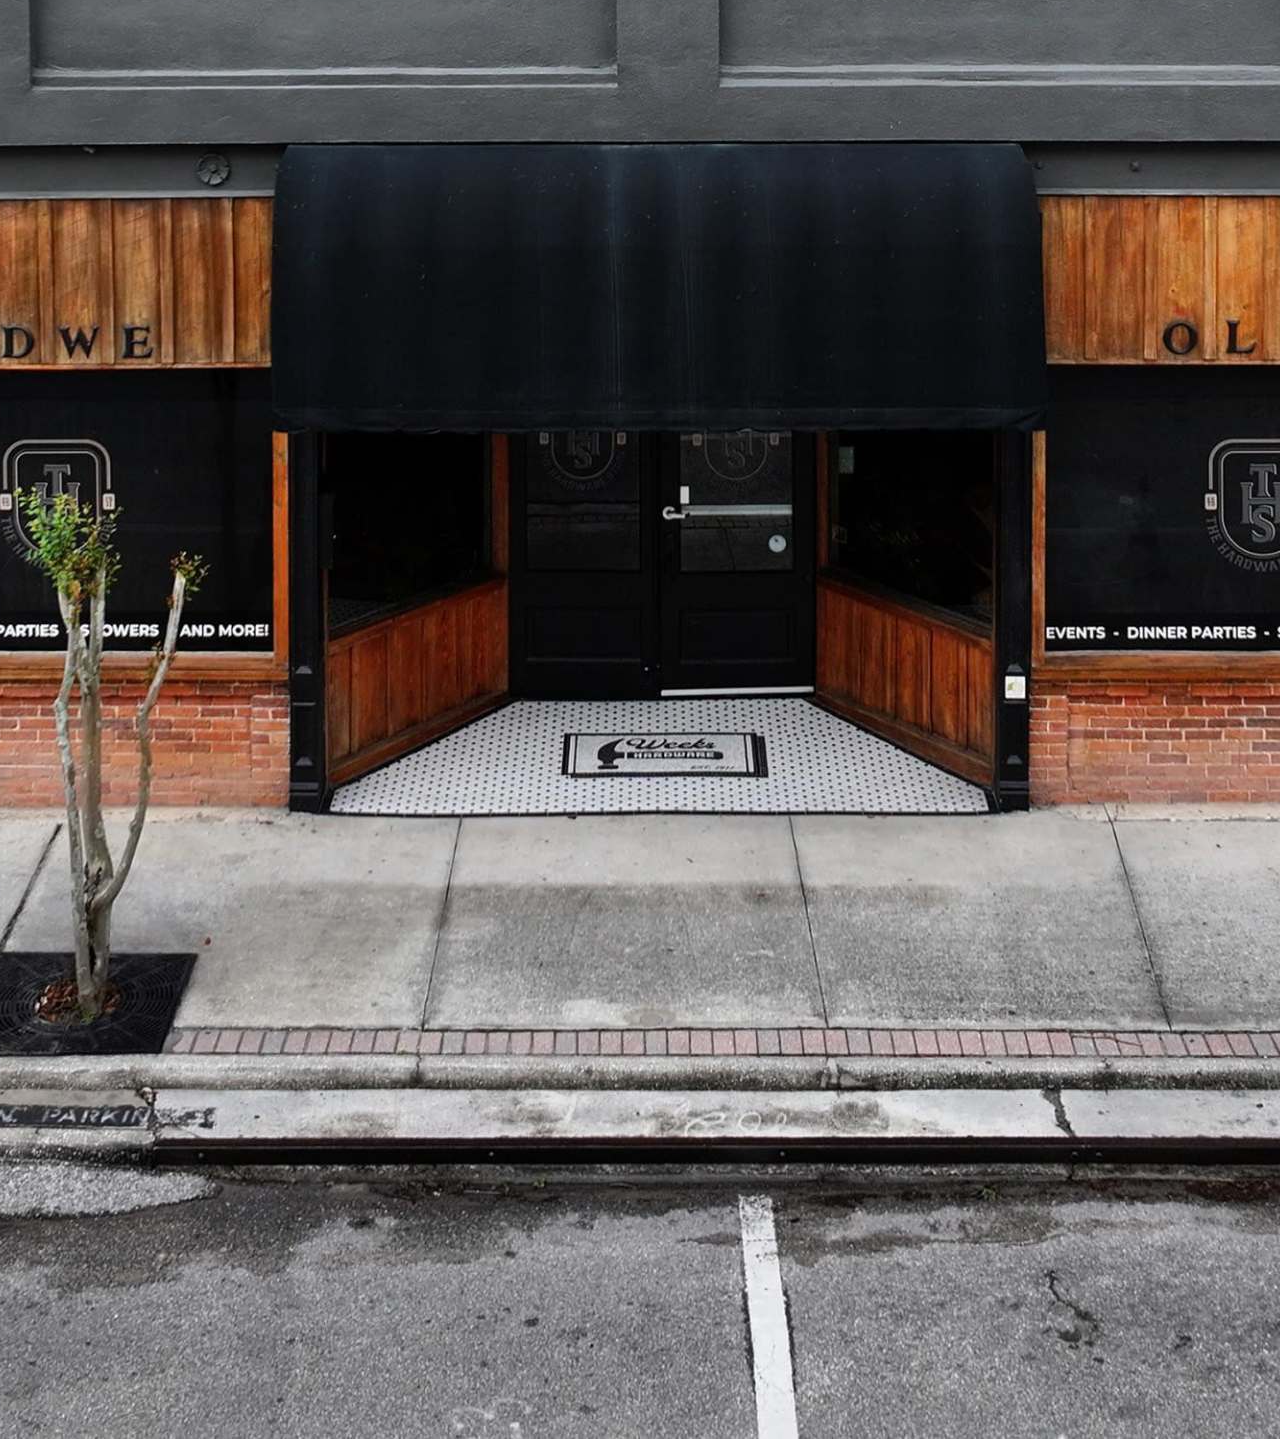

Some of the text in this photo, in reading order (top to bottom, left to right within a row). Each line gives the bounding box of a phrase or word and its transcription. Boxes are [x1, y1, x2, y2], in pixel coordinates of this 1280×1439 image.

[1205, 516, 1223, 544] THE
[80, 624, 160, 637] SOWERS
[179, 624, 215, 637] AND
[218, 624, 269, 638] MORE!
[1045, 626, 1106, 640] EVENTS
[1127, 626, 1188, 639] DINNER
[1191, 625, 1257, 639] PARTIES
[626, 737, 715, 750] Weeks
[633, 751, 715, 760] HARDWARE
[42, 1107, 152, 1124] PARKIN
